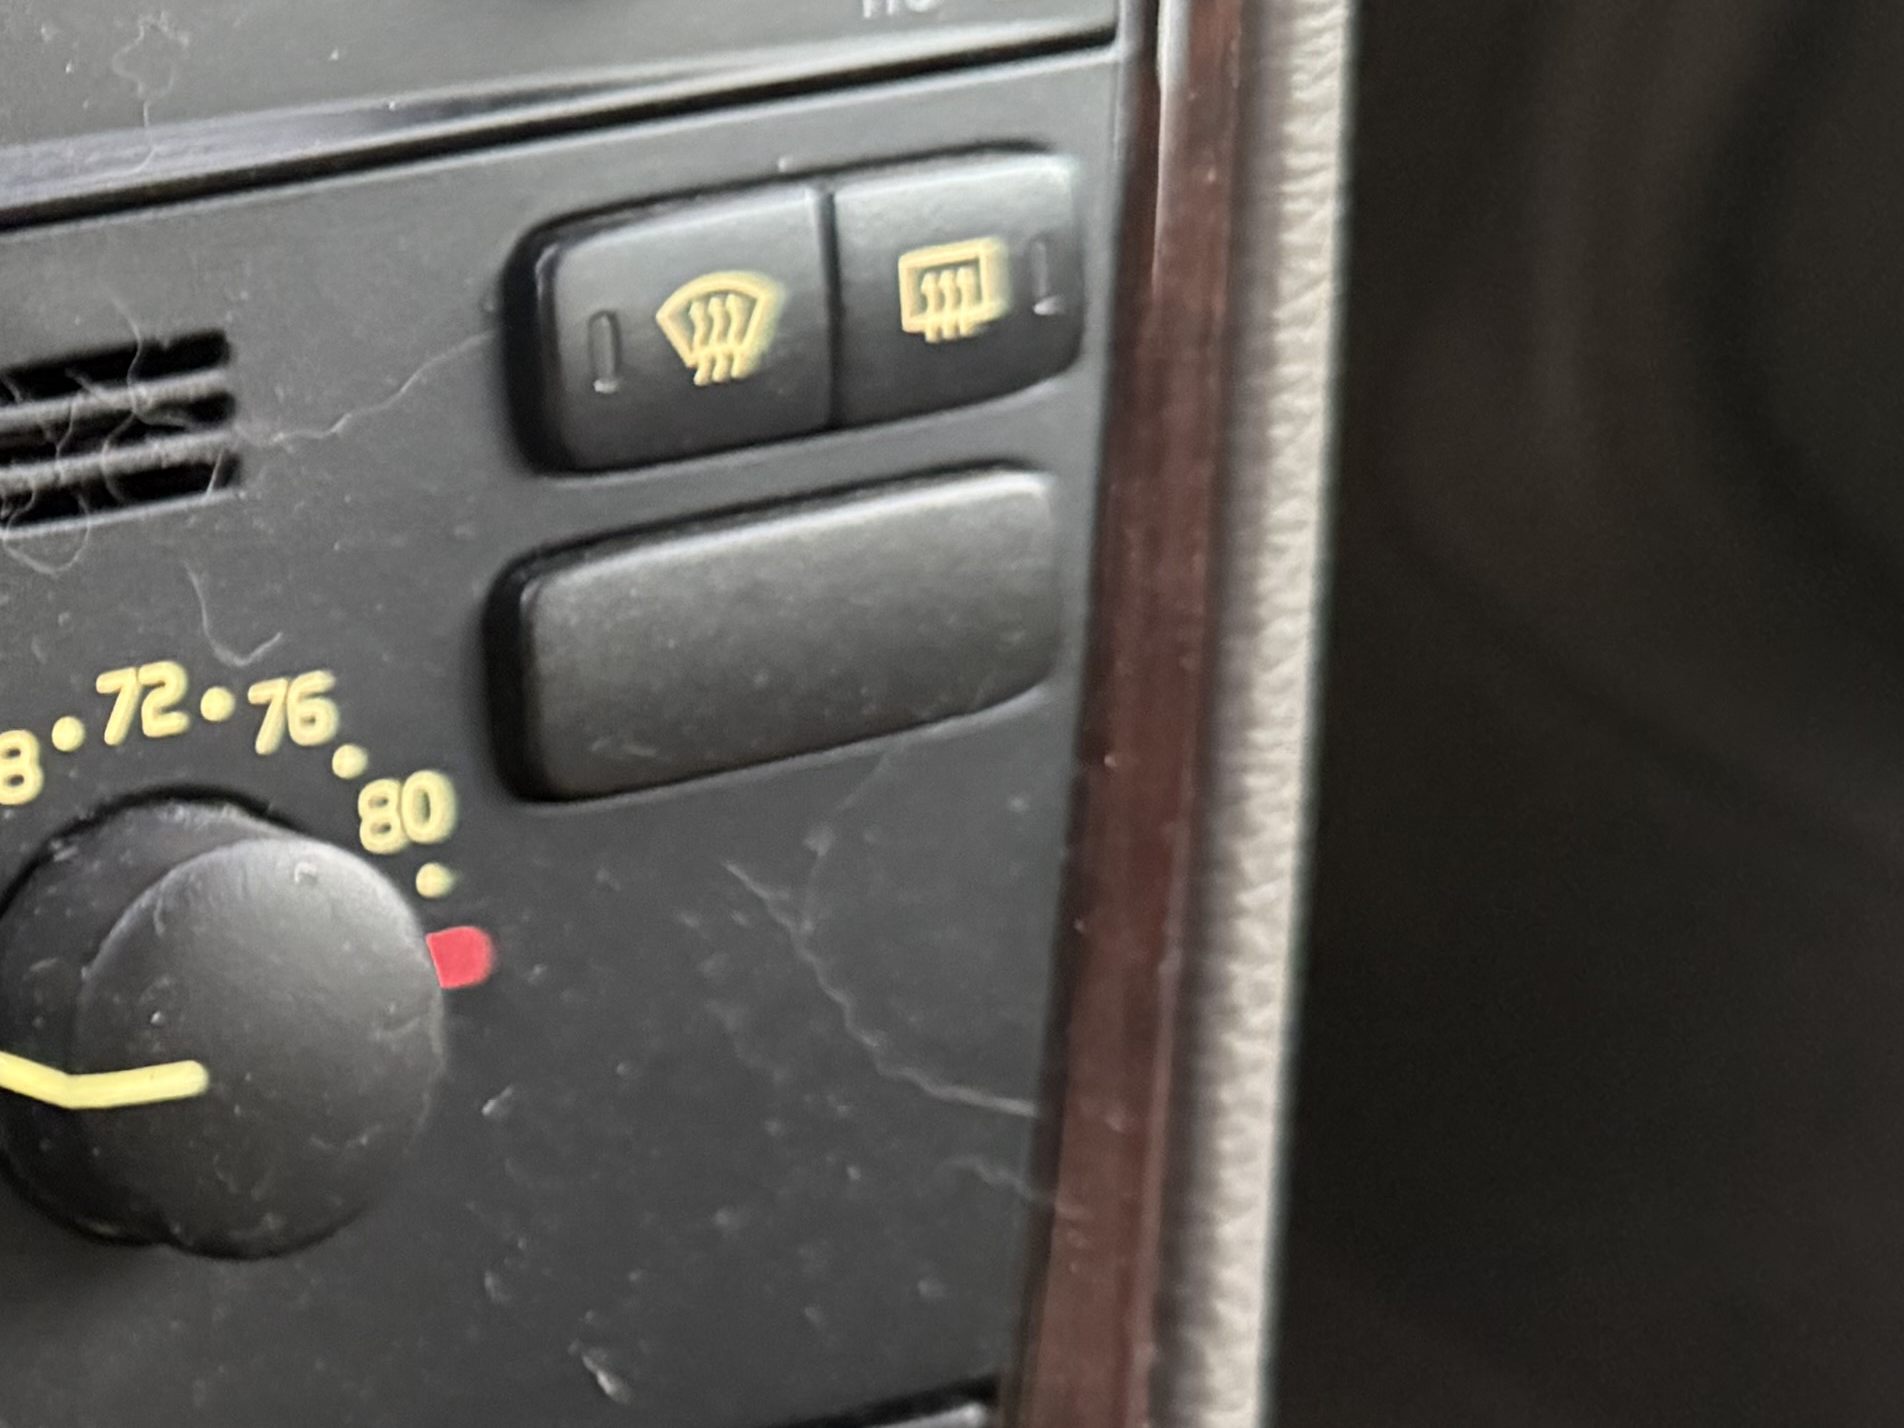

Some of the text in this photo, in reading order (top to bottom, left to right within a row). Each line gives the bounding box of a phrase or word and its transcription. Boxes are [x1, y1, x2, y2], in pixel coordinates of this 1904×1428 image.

[96, 660, 190, 747] 72
[247, 670, 339, 755] 76
[357, 769, 457, 855] 80
